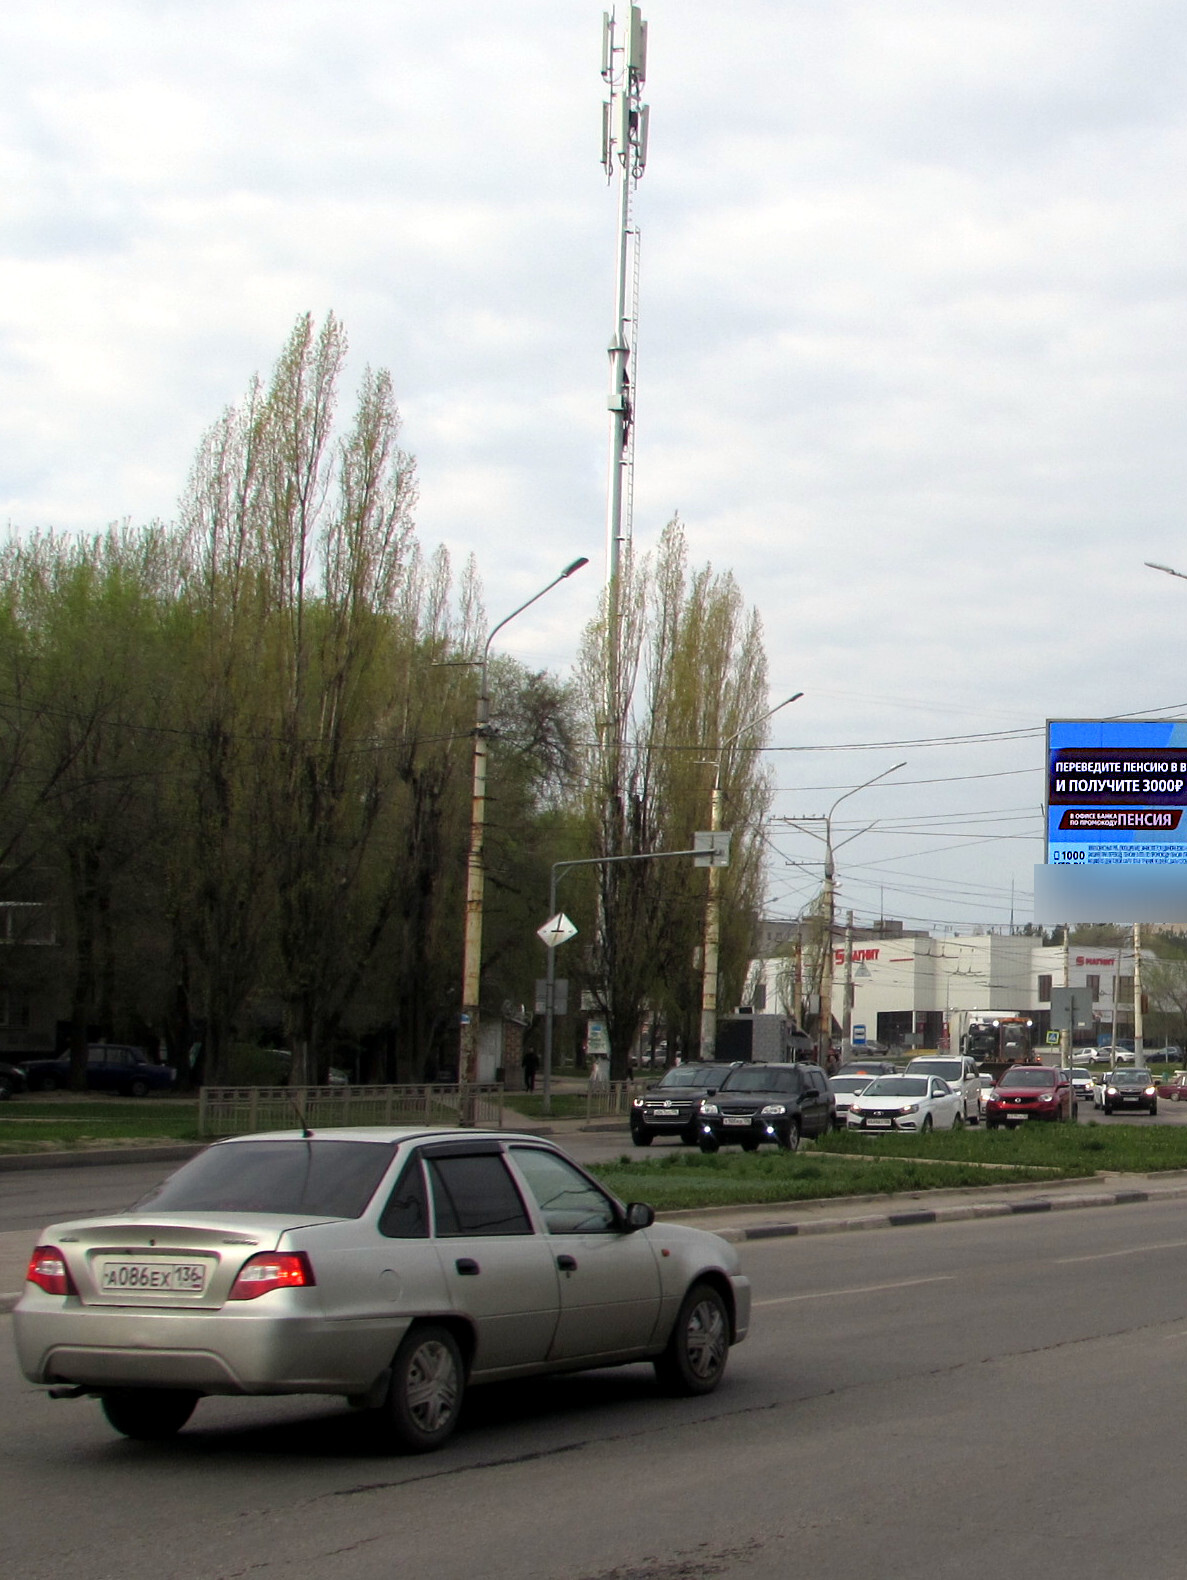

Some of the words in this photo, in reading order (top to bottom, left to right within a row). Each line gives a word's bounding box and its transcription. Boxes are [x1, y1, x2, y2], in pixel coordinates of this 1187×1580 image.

[1055, 762, 1121, 774] ПЕРЕВЕДИТЕ
[1123, 762, 1169, 773] ПЕНСИЮ
[1170, 762, 1178, 773] В
[1055, 779, 1066, 792] И
[1069, 779, 1140, 792] ПОЛУЧИТЕ
[1117, 813, 1172, 826] ПЕНСИЯ
[1062, 851, 1085, 861] 1000
[108, 1267, 172, 1287] А086ЕХ
[174, 1267, 199, 1282] 136
